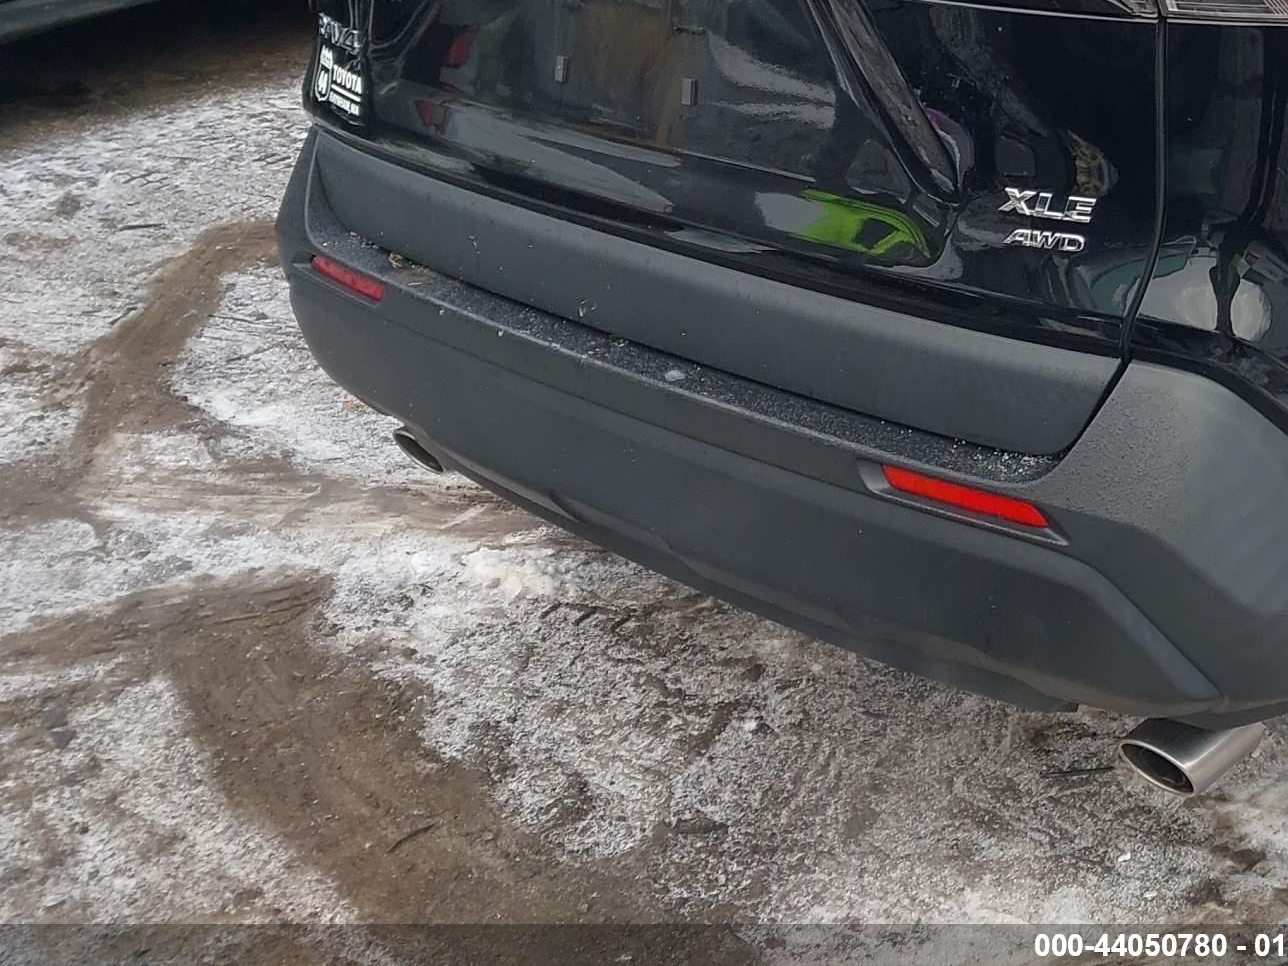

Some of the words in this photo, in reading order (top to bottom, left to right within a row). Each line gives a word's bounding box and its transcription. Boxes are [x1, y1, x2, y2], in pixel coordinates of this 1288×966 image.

[318, 13, 361, 55] RAV4
[332, 63, 362, 95] TOYOTA
[997, 186, 1097, 224] XLE
[1001, 228, 1085, 252] AWD
